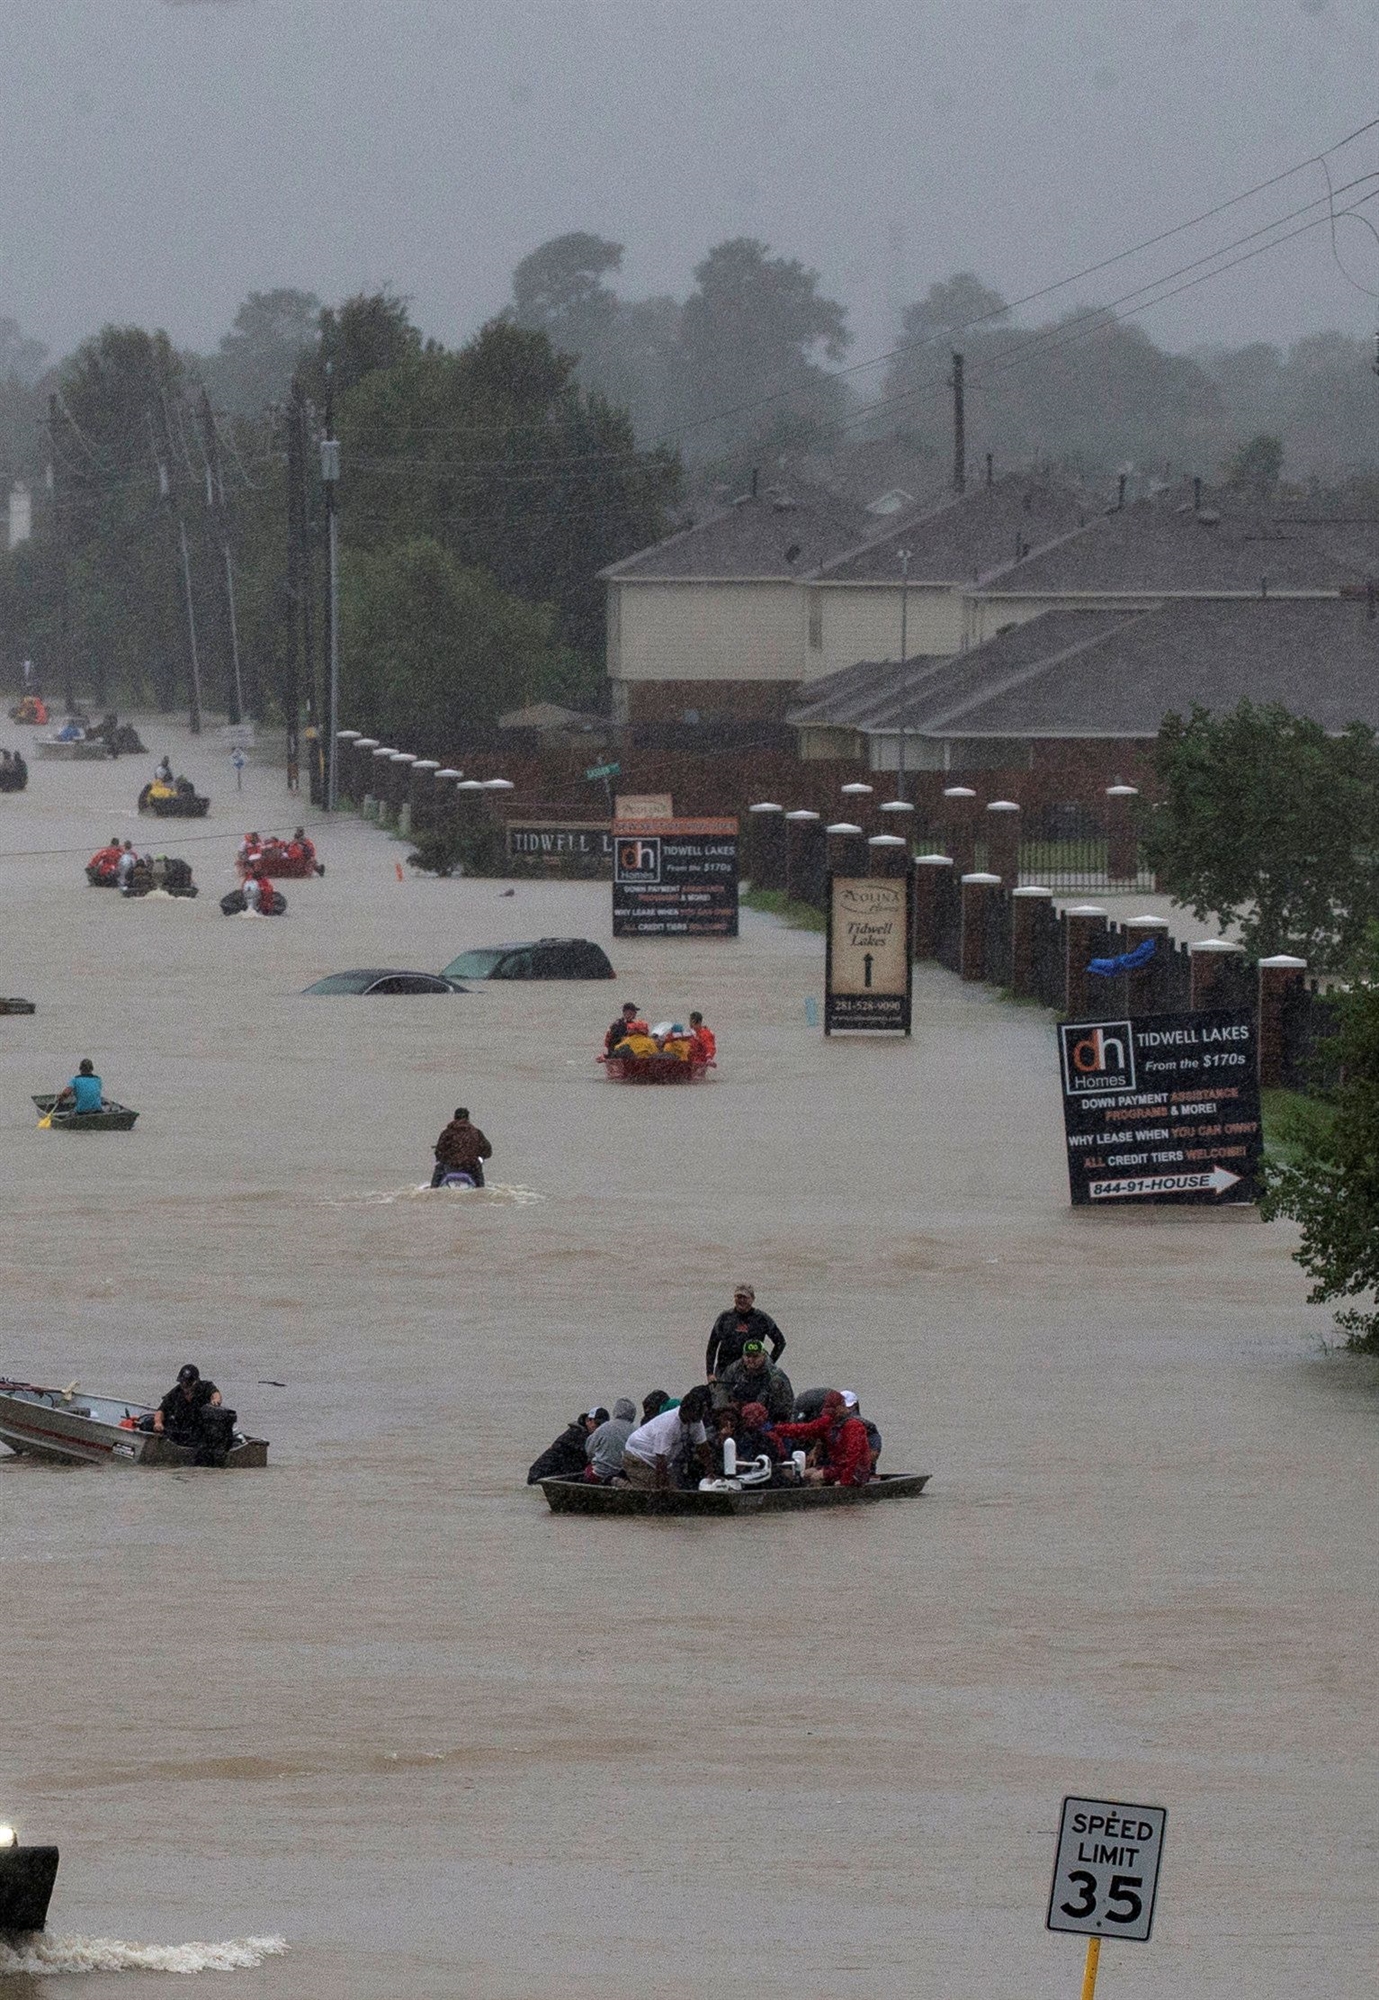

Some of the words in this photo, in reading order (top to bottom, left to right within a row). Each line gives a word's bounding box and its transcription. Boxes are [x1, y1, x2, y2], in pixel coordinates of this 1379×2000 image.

[621, 841, 654, 869] dh
[663, 846, 702, 856] TIDWELL
[704, 846, 735, 856] LAKES
[847, 922, 893, 935] Tidwell
[850, 935, 886, 947] Lakes
[1137, 1031, 1198, 1047] TIDWELL
[1202, 1026, 1249, 1042] LAKES
[1072, 1028, 1124, 1073] dh
[1145, 1059, 1176, 1072] From
[1180, 1058, 1199, 1069] the
[1203, 1053, 1246, 1068] $170s
[1075, 1075, 1127, 1089] Homes
[1081, 1098, 1116, 1110] DOWN
[1118, 1092, 1169, 1106] PAYMENT
[1105, 1106, 1168, 1121] PROGRAMS
[1170, 1106, 1179, 1116] &
[1181, 1103, 1217, 1115] MORE!
[1068, 1134, 1094, 1146] WHY
[1096, 1132, 1134, 1144] LEASE
[1136, 1129, 1170, 1141] WHEN
[1171, 1126, 1195, 1138] YOU
[1198, 1124, 1222, 1136] CAN
[1083, 1157, 1105, 1168] ALL
[1107, 1153, 1149, 1166] CREDIT
[1151, 1150, 1183, 1163] TIERS
[1093, 1174, 1211, 1195] 844-91-HOUSE
[1071, 1813, 1153, 1841] SPEED
[1078, 1842, 1140, 1868] LIMIT
[1060, 1870, 1143, 1924] 35
